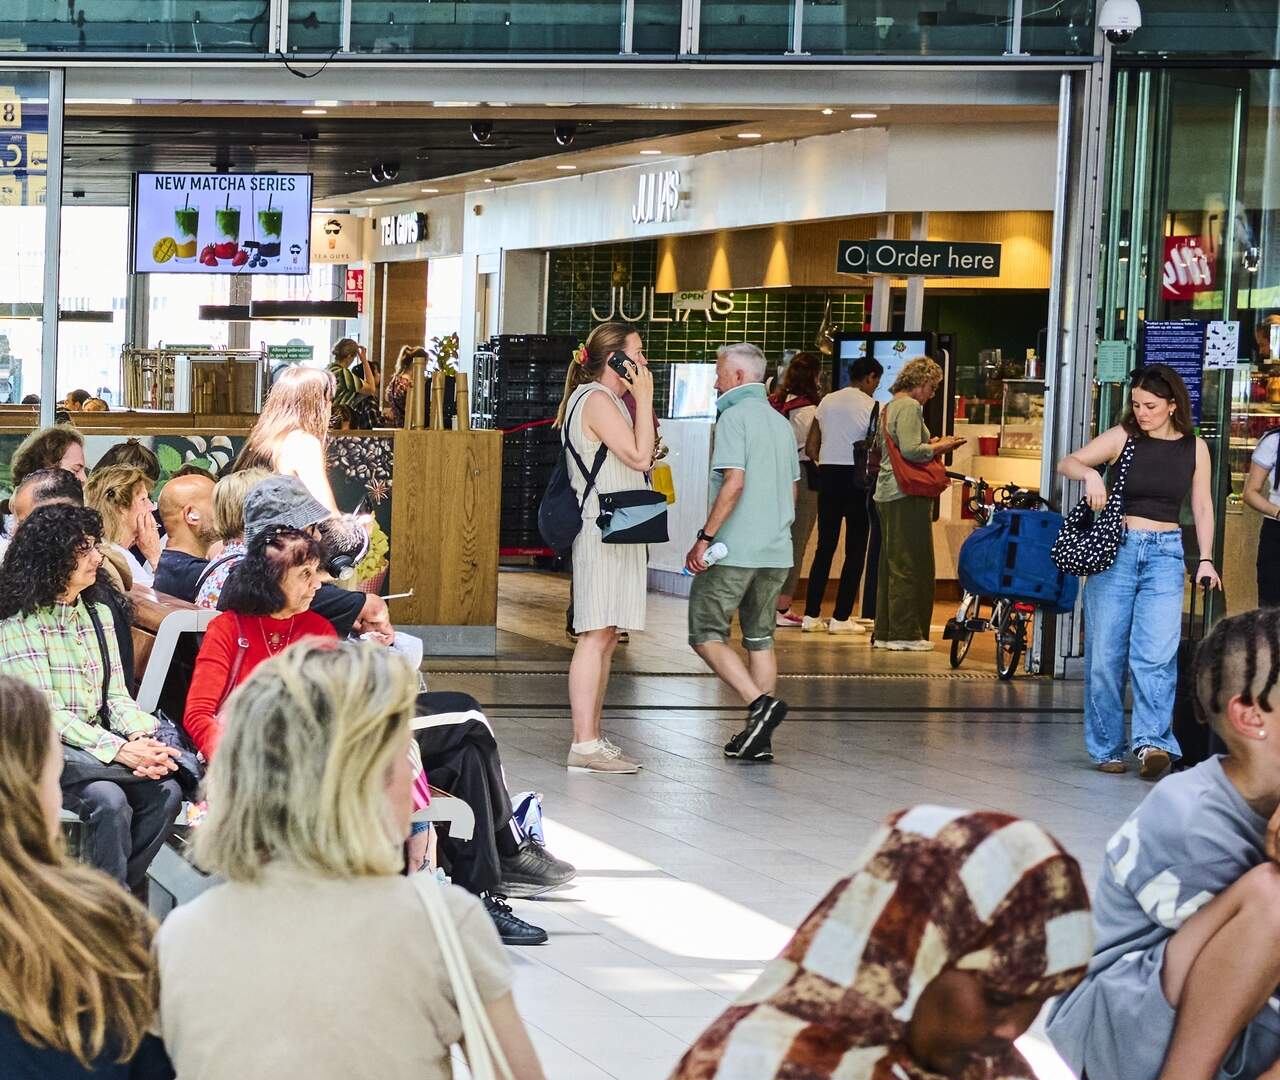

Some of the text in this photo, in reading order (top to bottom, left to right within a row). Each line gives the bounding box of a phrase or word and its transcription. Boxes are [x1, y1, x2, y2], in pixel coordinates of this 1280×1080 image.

[155, 177, 296, 192] NEW MATCHA SERIES
[876, 245, 995, 269] Order here
[680, 292, 704, 300] OPEN
